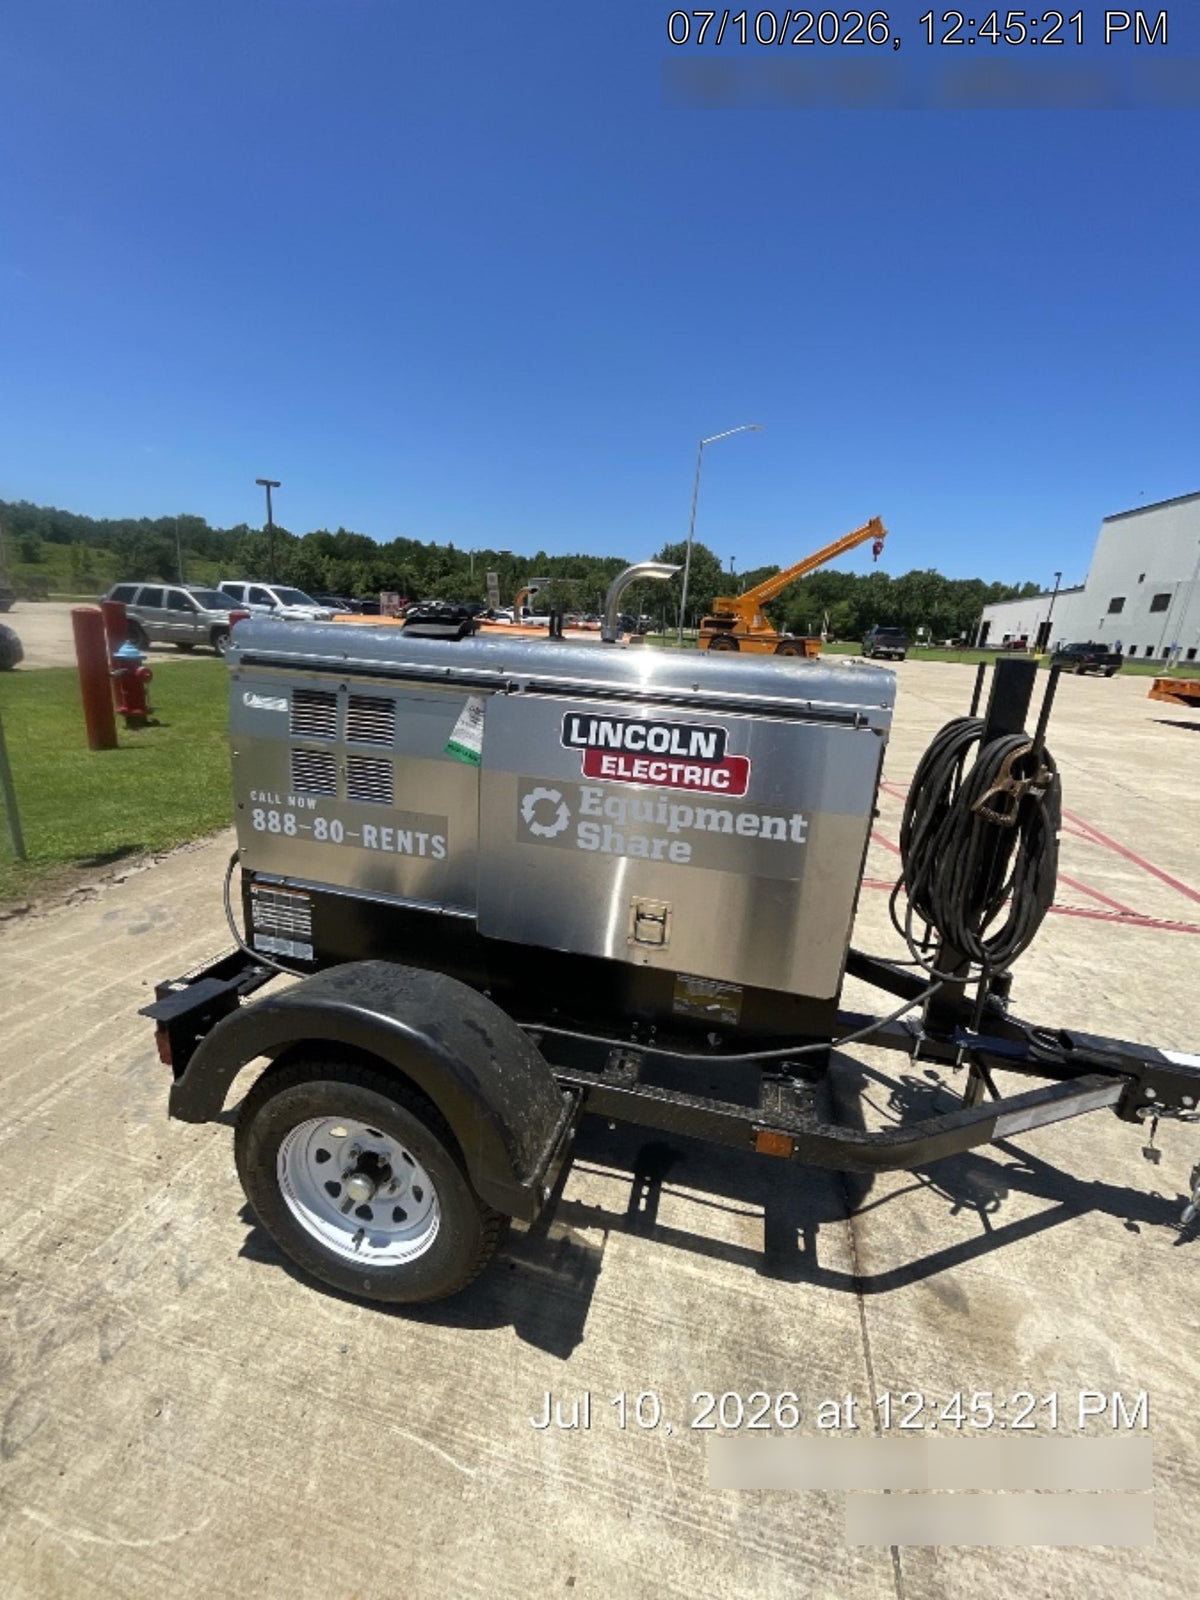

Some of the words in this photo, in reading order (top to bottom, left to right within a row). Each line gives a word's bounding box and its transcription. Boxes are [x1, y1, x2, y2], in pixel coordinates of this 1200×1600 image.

[569, 717, 718, 759] LINCOLN
[600, 755, 731, 789] ELECTRIC
[250, 790, 282, 805] CALL
[288, 796, 317, 810] NOW
[578, 785, 808, 844] Equipment
[252, 808, 446, 860] 888-80-RENTS
[576, 821, 692, 864] Share
